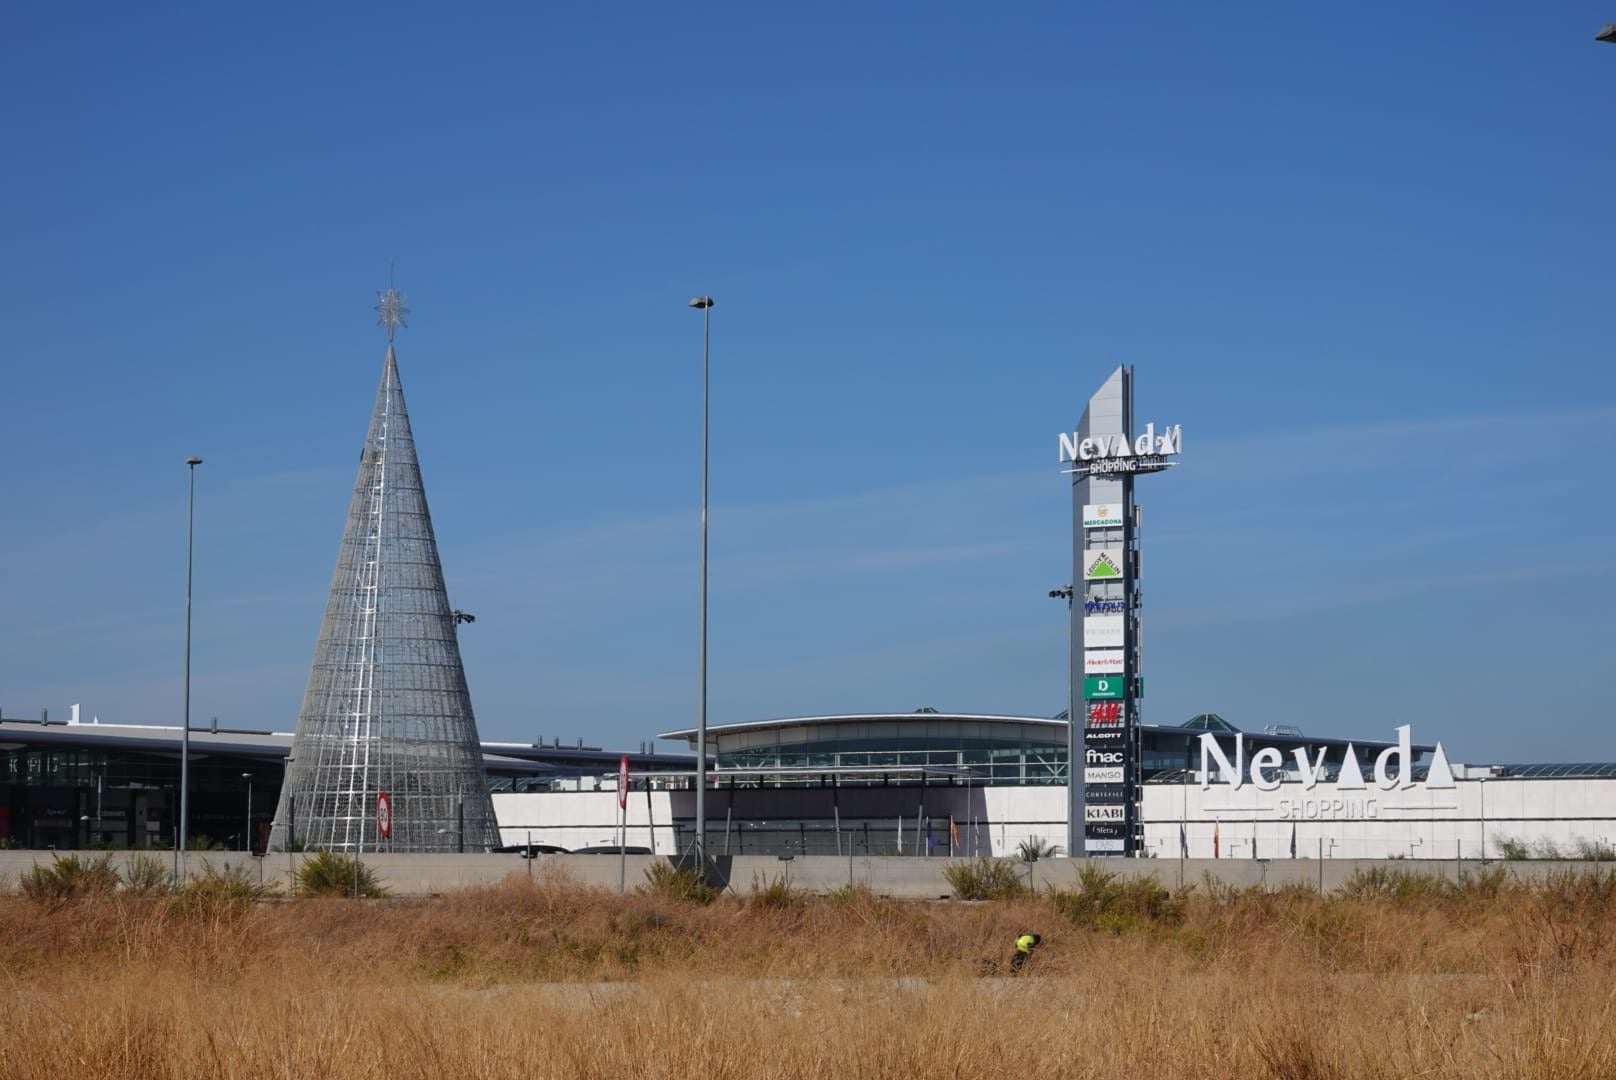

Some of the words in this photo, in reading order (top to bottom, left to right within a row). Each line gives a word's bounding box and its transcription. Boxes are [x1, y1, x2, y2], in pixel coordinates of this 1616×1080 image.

[1090, 460, 1136, 474] SHOPPING
[1098, 680, 1109, 691] D
[1086, 749, 1124, 763] fnac
[1087, 771, 1122, 779] MANGO
[1087, 808, 1123, 818] KIABI
[1279, 799, 1377, 819] SHOPPING
